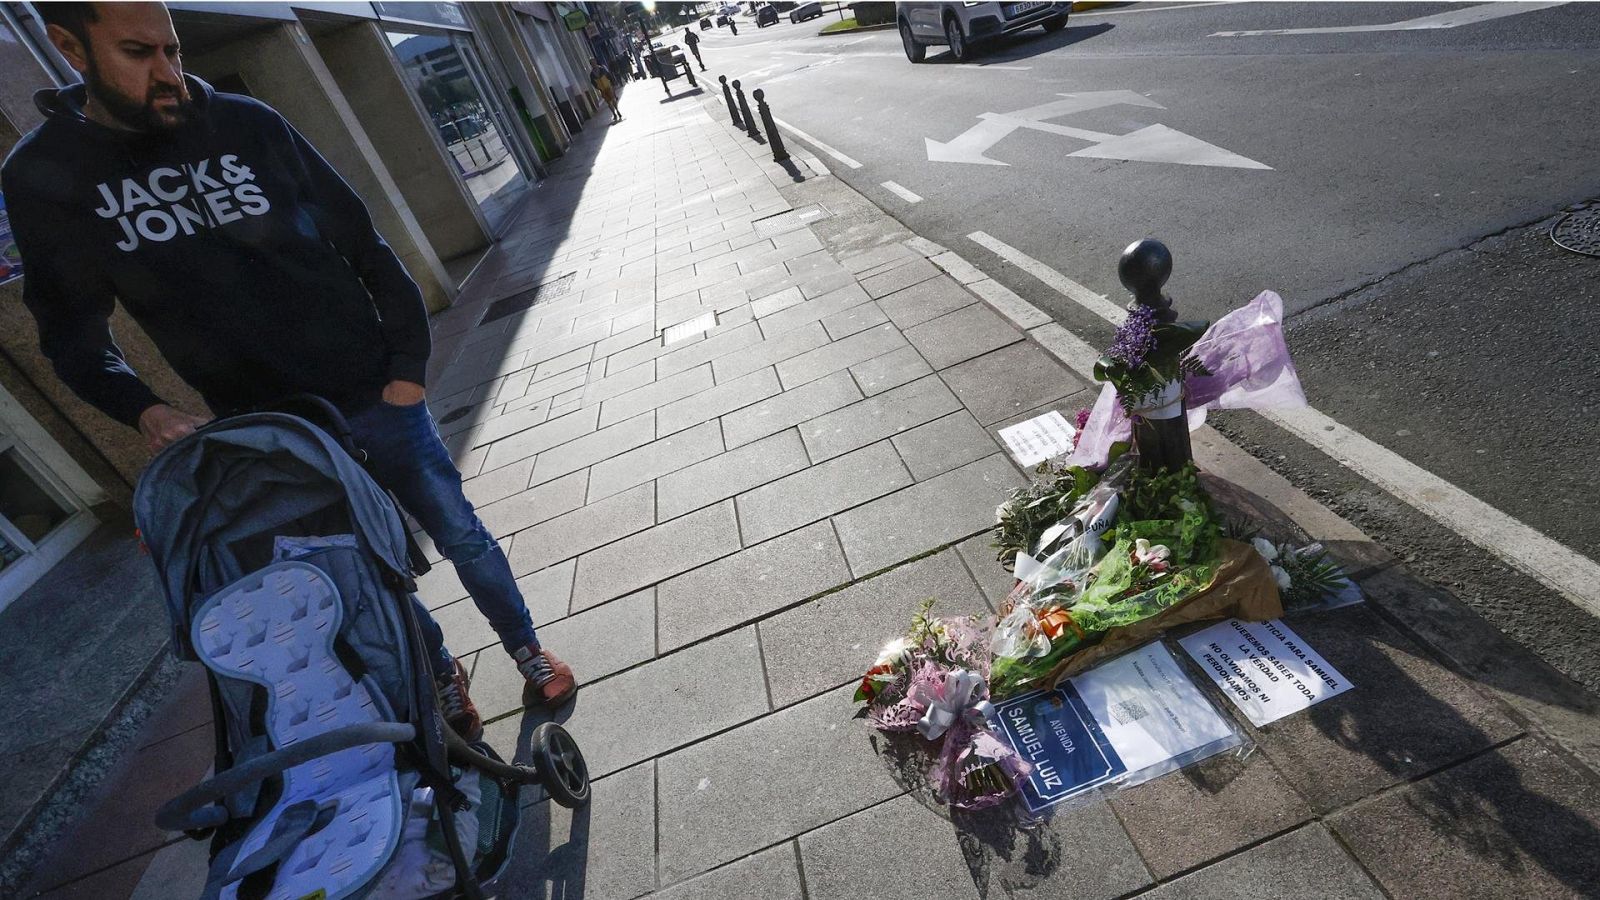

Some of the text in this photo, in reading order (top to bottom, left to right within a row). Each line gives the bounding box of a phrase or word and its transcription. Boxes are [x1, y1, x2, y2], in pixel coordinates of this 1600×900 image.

[116, 183, 271, 251] JONES
[1203, 653, 1251, 702] PERDONAMOS
[1209, 642, 1271, 703] NO OLVIDAMOS NI
[1230, 621, 1316, 701] QUEREMOS SABER TODA
[1238, 644, 1280, 683] LA VERDAD
[1261, 619, 1339, 690] STICIA PARA SAMUEL
[1008, 707, 1063, 790] SAMUEL LUIZ
[1050, 719, 1076, 754] AVENIDA
